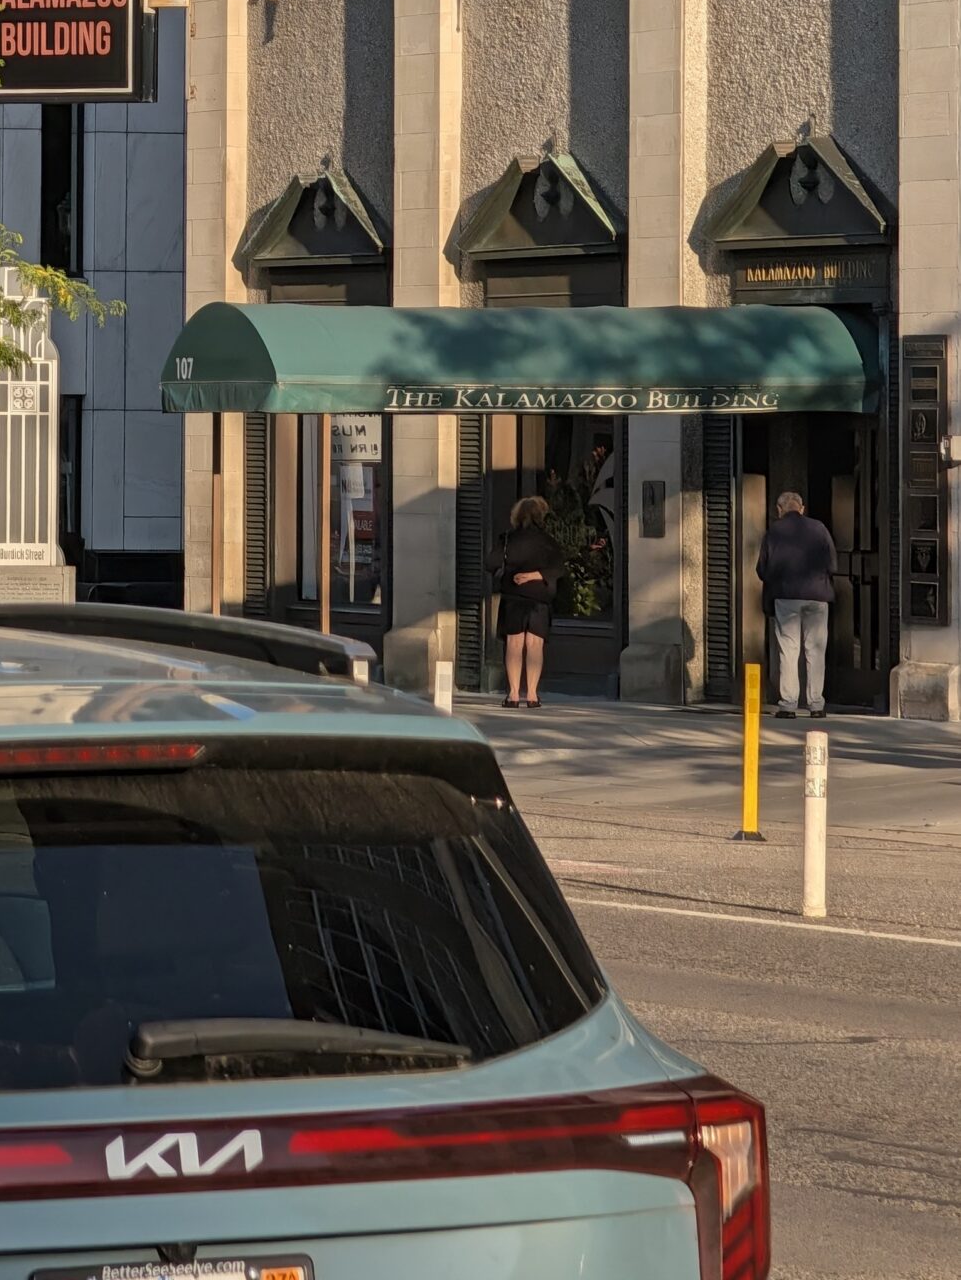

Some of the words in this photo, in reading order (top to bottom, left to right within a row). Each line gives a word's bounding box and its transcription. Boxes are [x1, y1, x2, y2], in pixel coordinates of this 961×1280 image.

[1, 21, 111, 57] BUILDING
[746, 261, 816, 282] KALAMAZOO
[175, 357, 194, 380] 107
[387, 388, 443, 408] THE
[454, 388, 638, 409] KALAMAZOO
[646, 390, 780, 409] BUILDING
[0, 548, 25, 560] Burdick
[25, 548, 45, 560] Street
[105, 1129, 264, 1181] KIA
